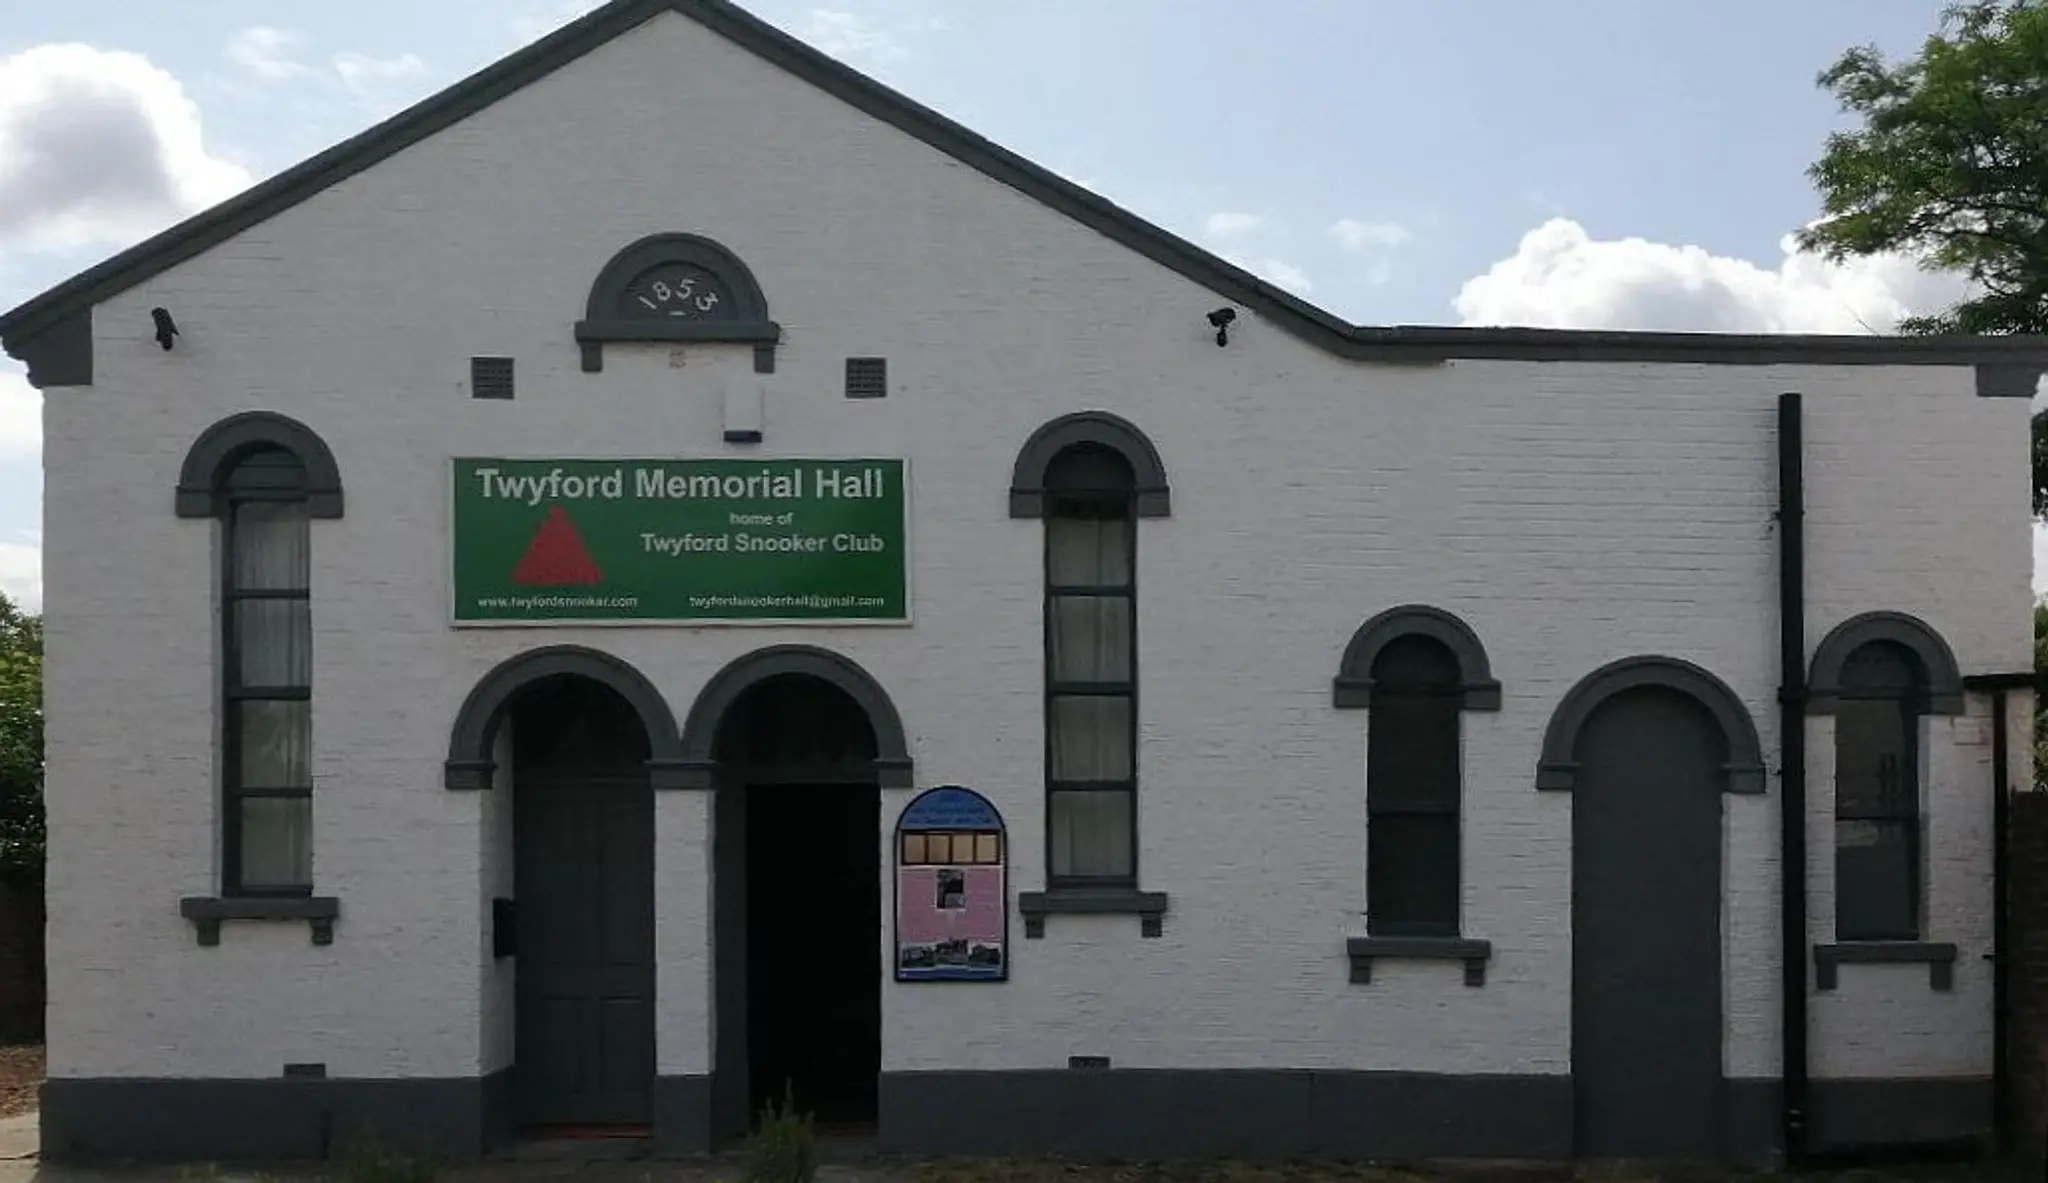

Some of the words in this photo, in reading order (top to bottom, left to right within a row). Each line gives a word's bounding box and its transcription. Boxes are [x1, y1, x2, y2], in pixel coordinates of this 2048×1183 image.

[475, 467, 623, 506] Twyford
[635, 467, 802, 499] Memorial
[815, 467, 884, 499] Hall
[729, 512, 774, 526] home
[777, 512, 794, 526] of
[640, 533, 729, 557] Twyford
[735, 533, 827, 552] Snooker
[832, 532, 884, 552] Club
